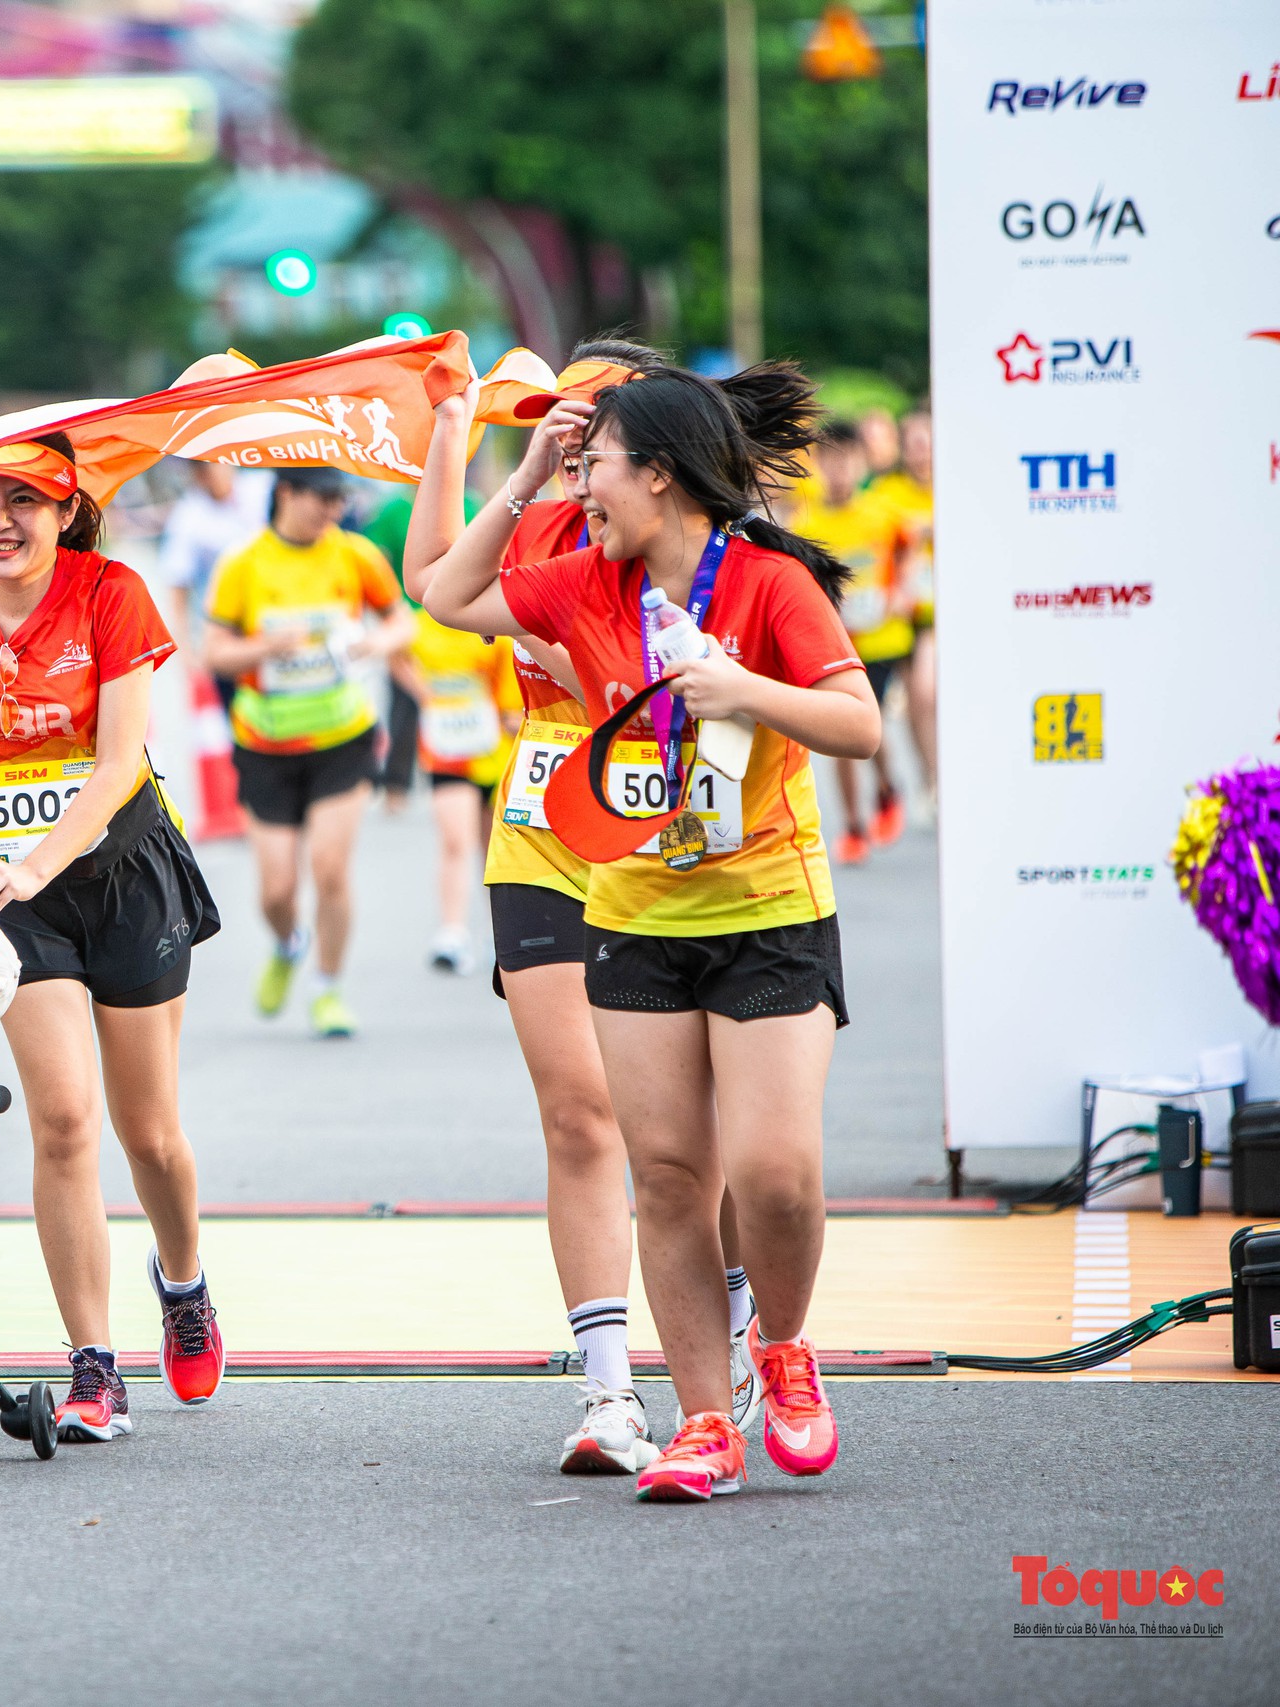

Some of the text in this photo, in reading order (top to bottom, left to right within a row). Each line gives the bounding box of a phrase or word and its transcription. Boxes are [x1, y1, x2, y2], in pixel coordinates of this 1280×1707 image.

[1051, 338, 1133, 367] PVI
[267, 438, 341, 461] BINH
[1020, 453, 1115, 488] TTH
[4, 768, 48, 781] 5KM
[624, 773, 714, 809] 501
[686, 841, 704, 854] BINH
[171, 917, 190, 944] T8
